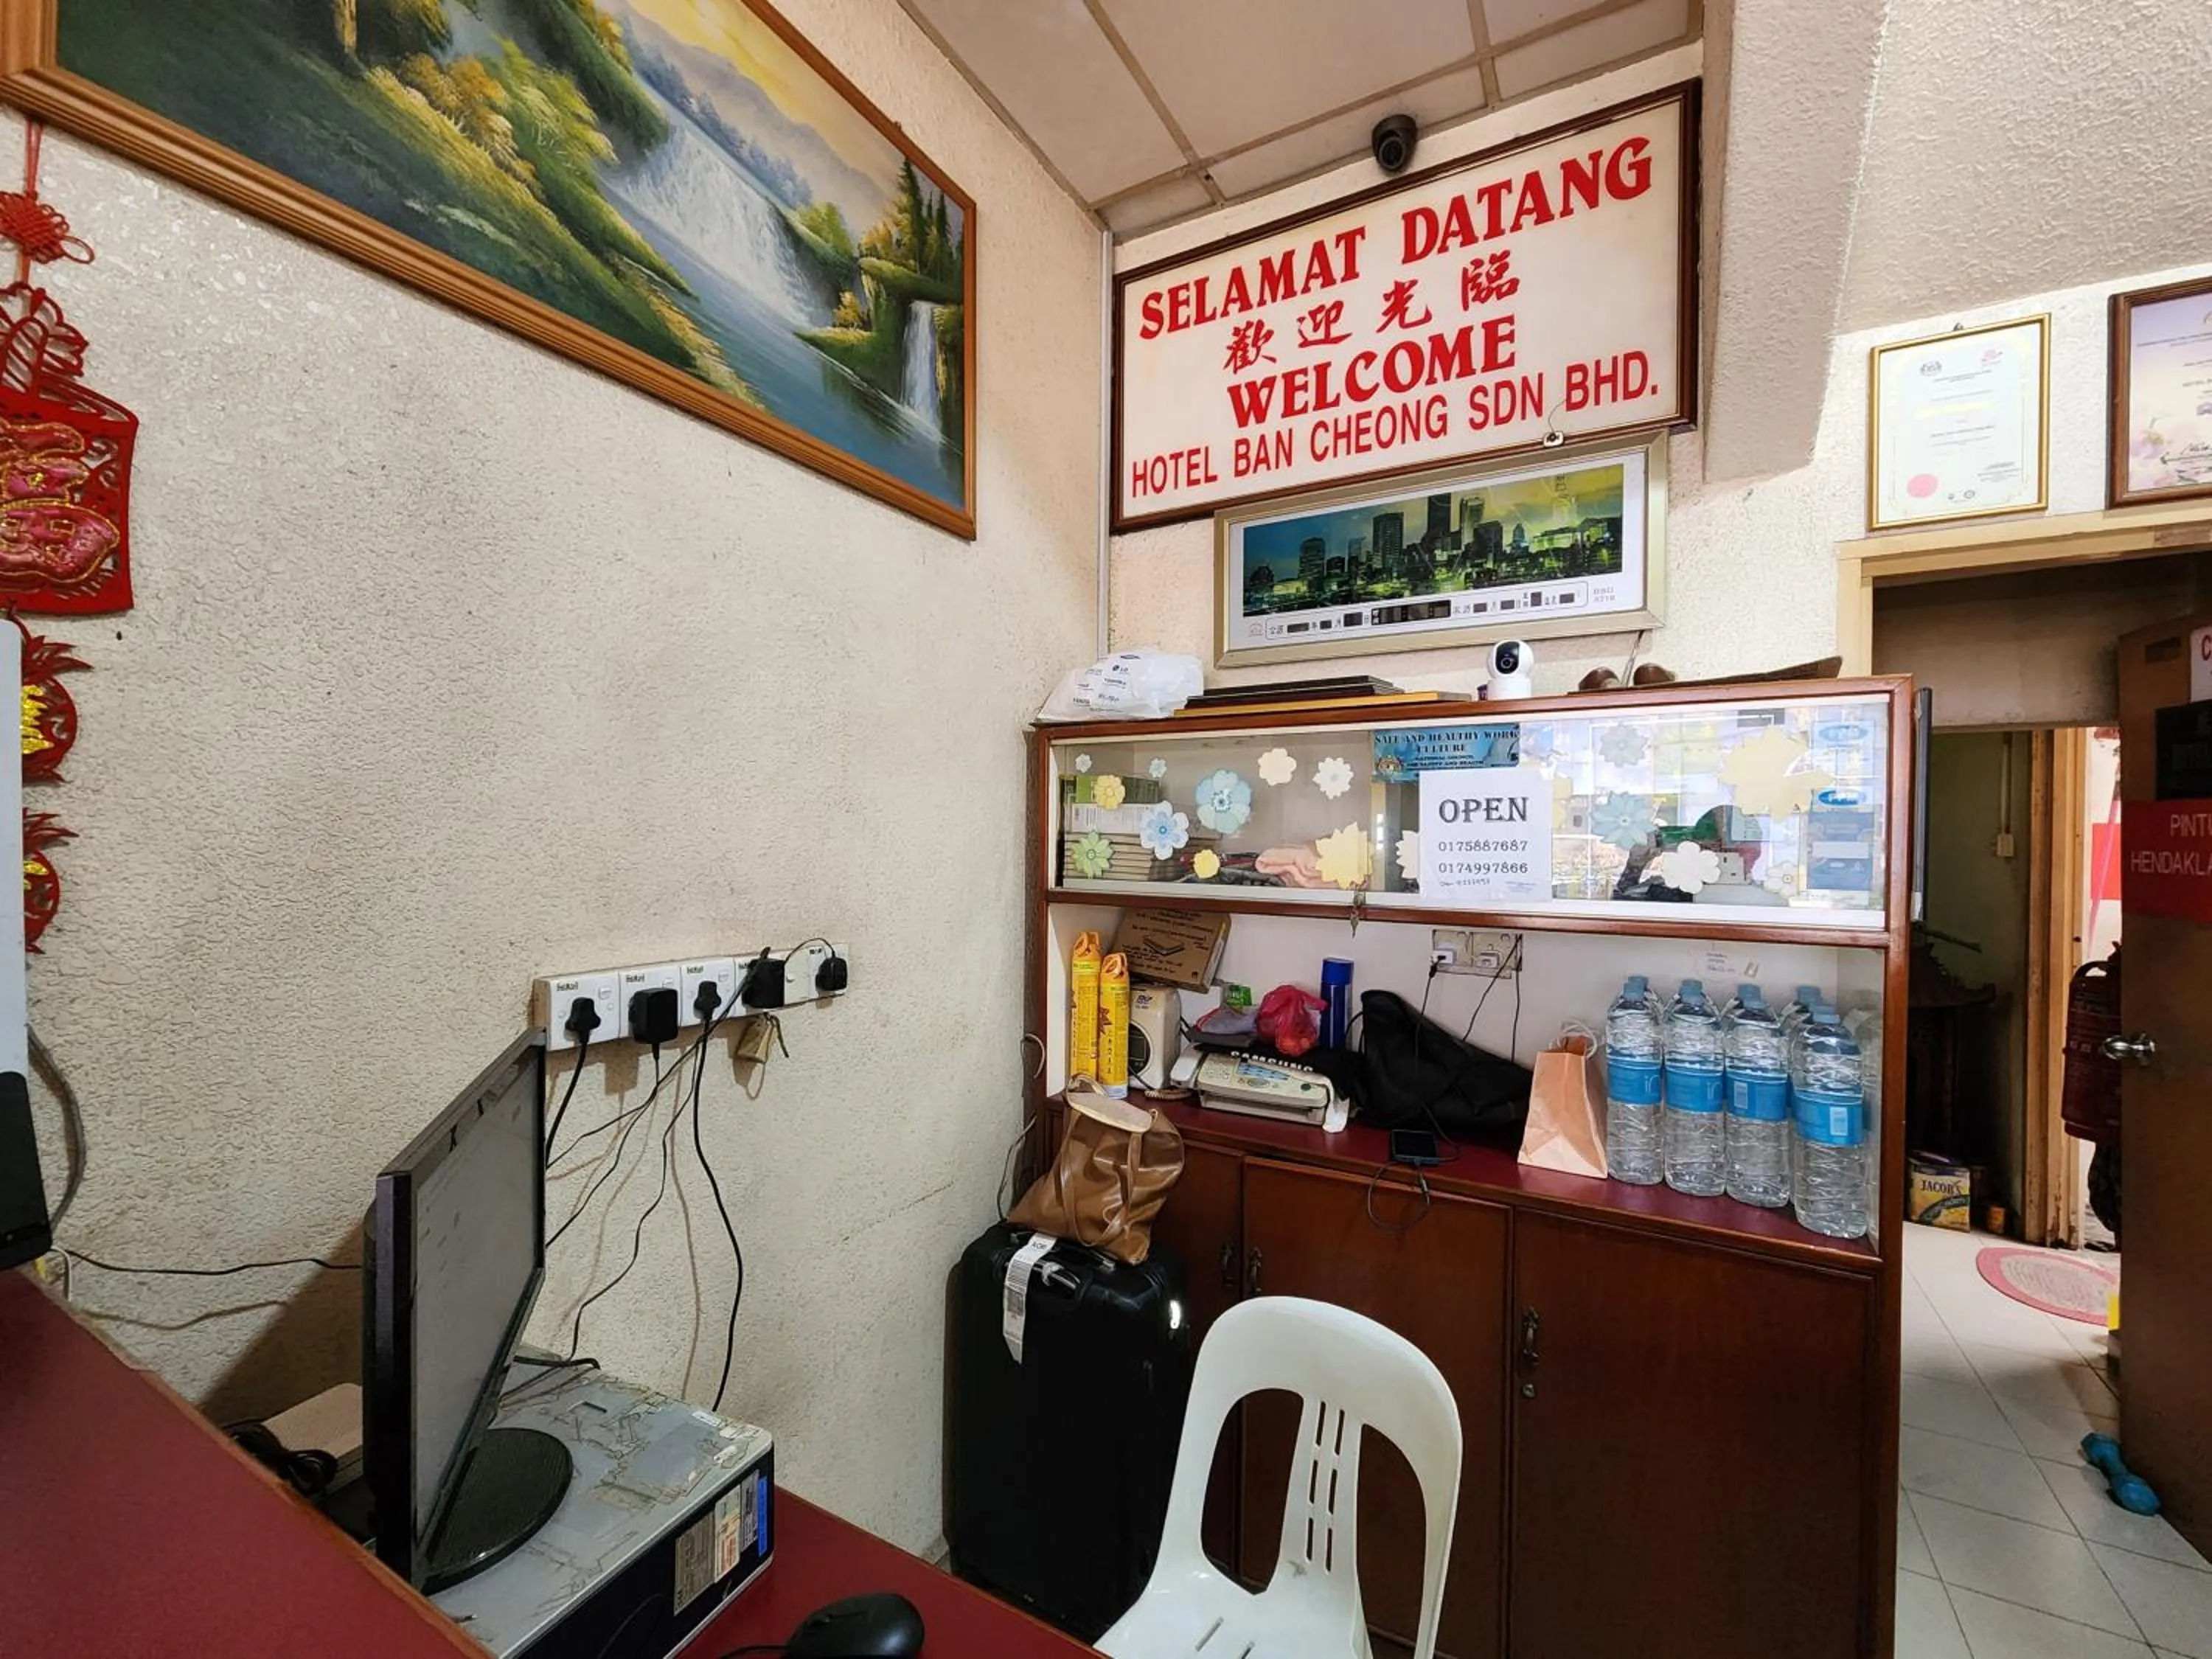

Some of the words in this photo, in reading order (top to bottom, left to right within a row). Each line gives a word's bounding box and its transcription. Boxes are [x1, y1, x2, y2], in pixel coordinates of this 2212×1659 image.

[1138, 226, 1367, 341] SELAMAT
[1402, 136, 1652, 265] DATANG
[1223, 249, 1520, 375] 歡迎光臨
[1227, 315, 1517, 429] WELCOME
[1132, 446, 1218, 498] HOTEL
[1234, 428, 1294, 479] BAN
[1310, 394, 1448, 463] CHEONG
[1467, 372, 1545, 431] SDN
[1563, 350, 1658, 411] BHD.
[1405, 734, 1425, 742] AND
[1428, 731, 1478, 742] HEALTHY
[1439, 797, 1528, 824] OPEN
[1439, 839, 1528, 852] 0175887687
[1439, 861, 1528, 874] 0174997866
[2130, 850, 2212, 876] HENDAKL
